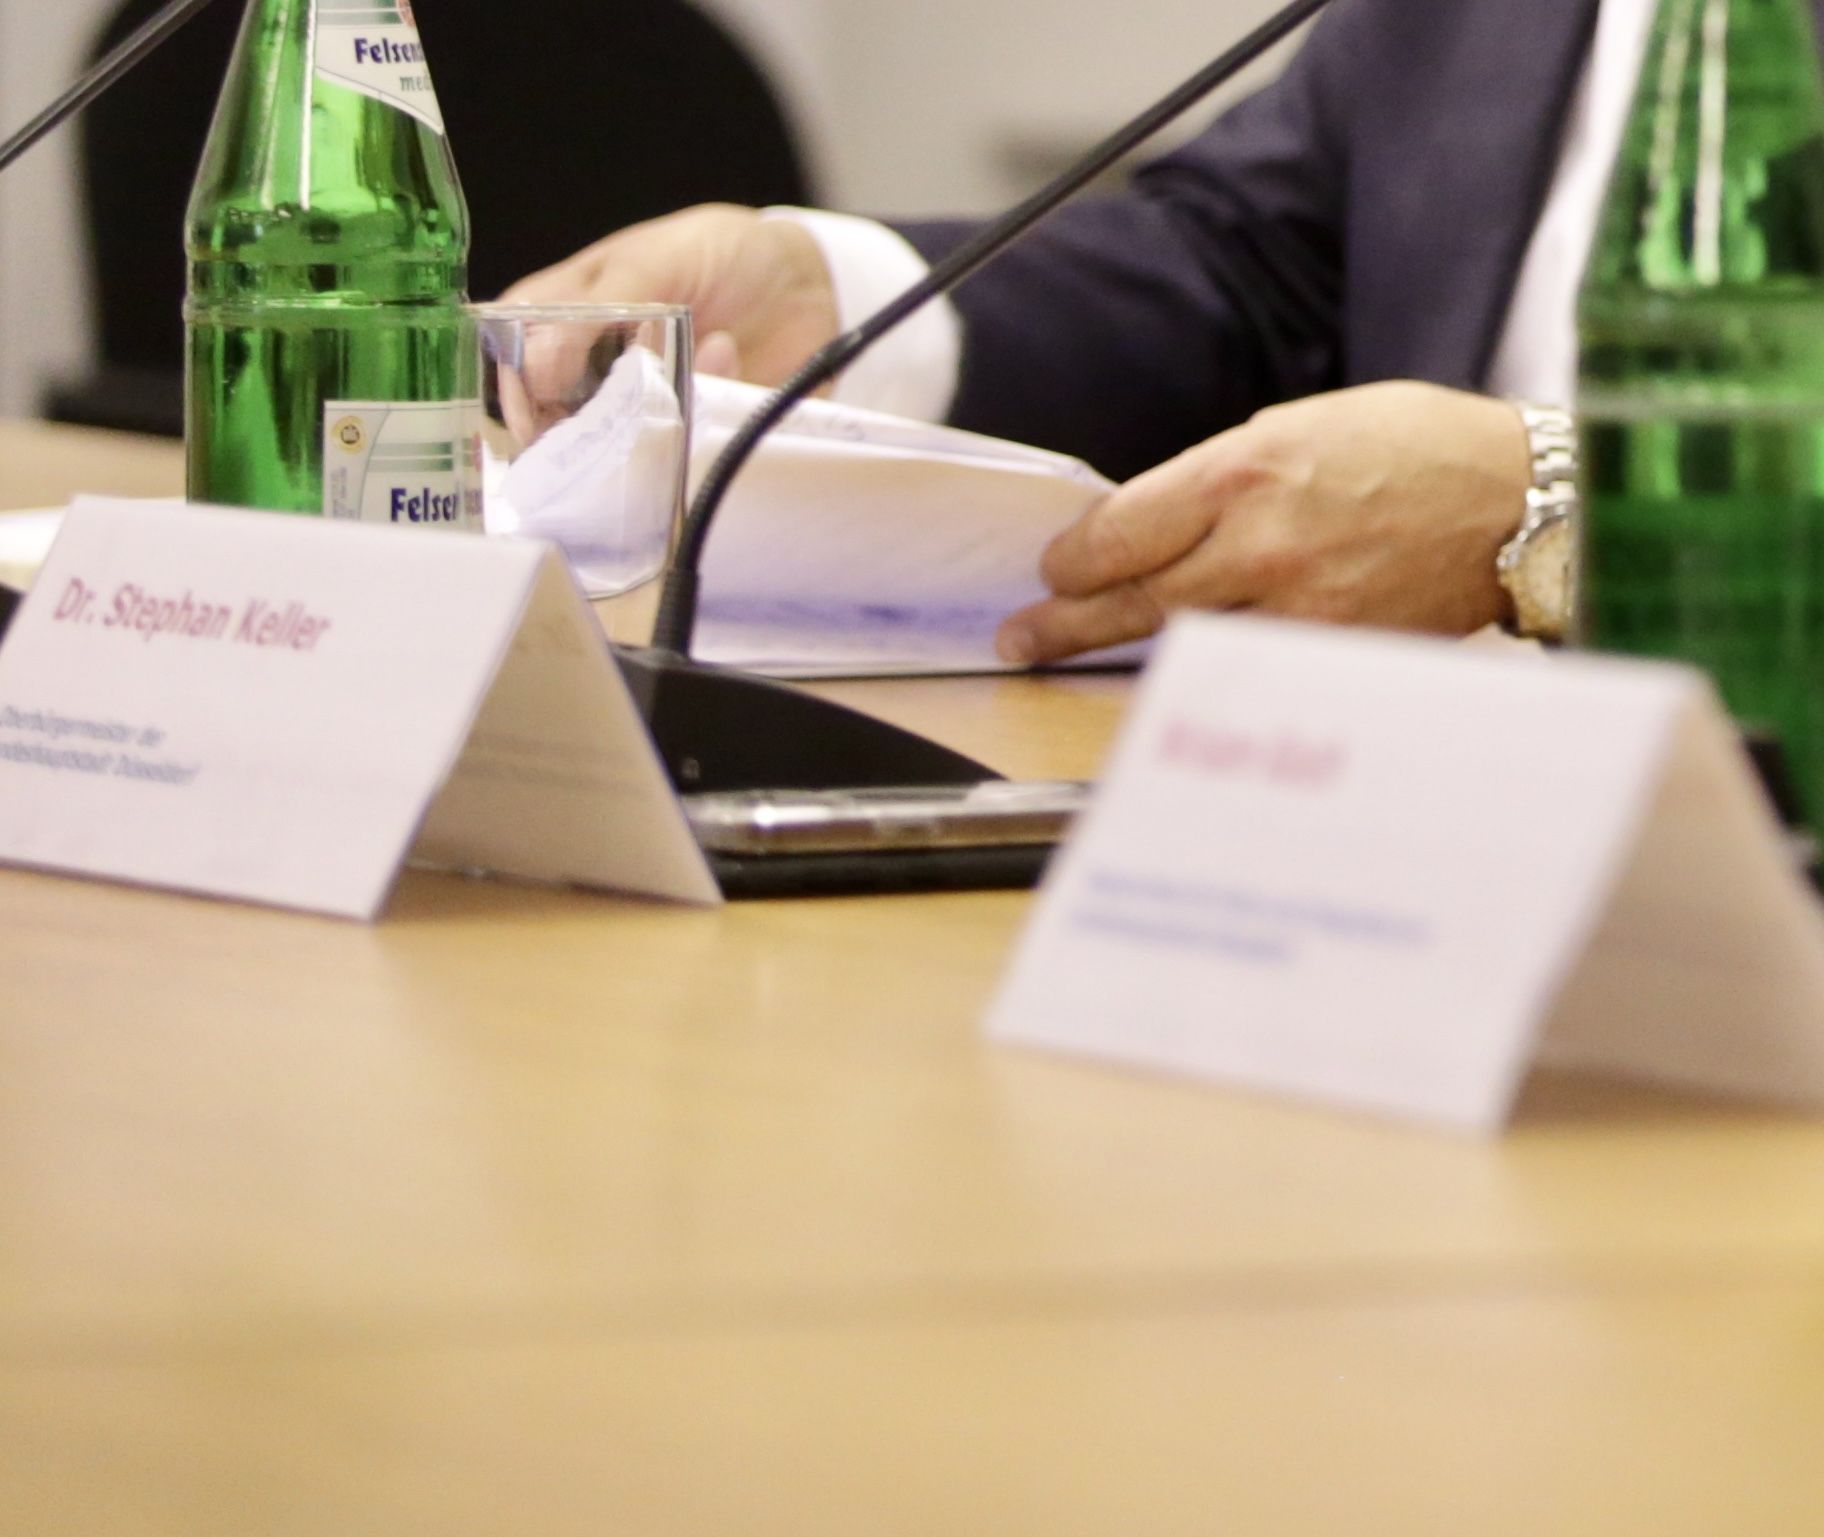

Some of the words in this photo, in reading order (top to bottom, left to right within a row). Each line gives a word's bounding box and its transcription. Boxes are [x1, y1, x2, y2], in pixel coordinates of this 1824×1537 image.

[353, 37, 426, 64] Felsen
[52, 577, 96, 624] Dr.
[103, 582, 232, 643] Stephan
[233, 596, 332, 651] Keller
